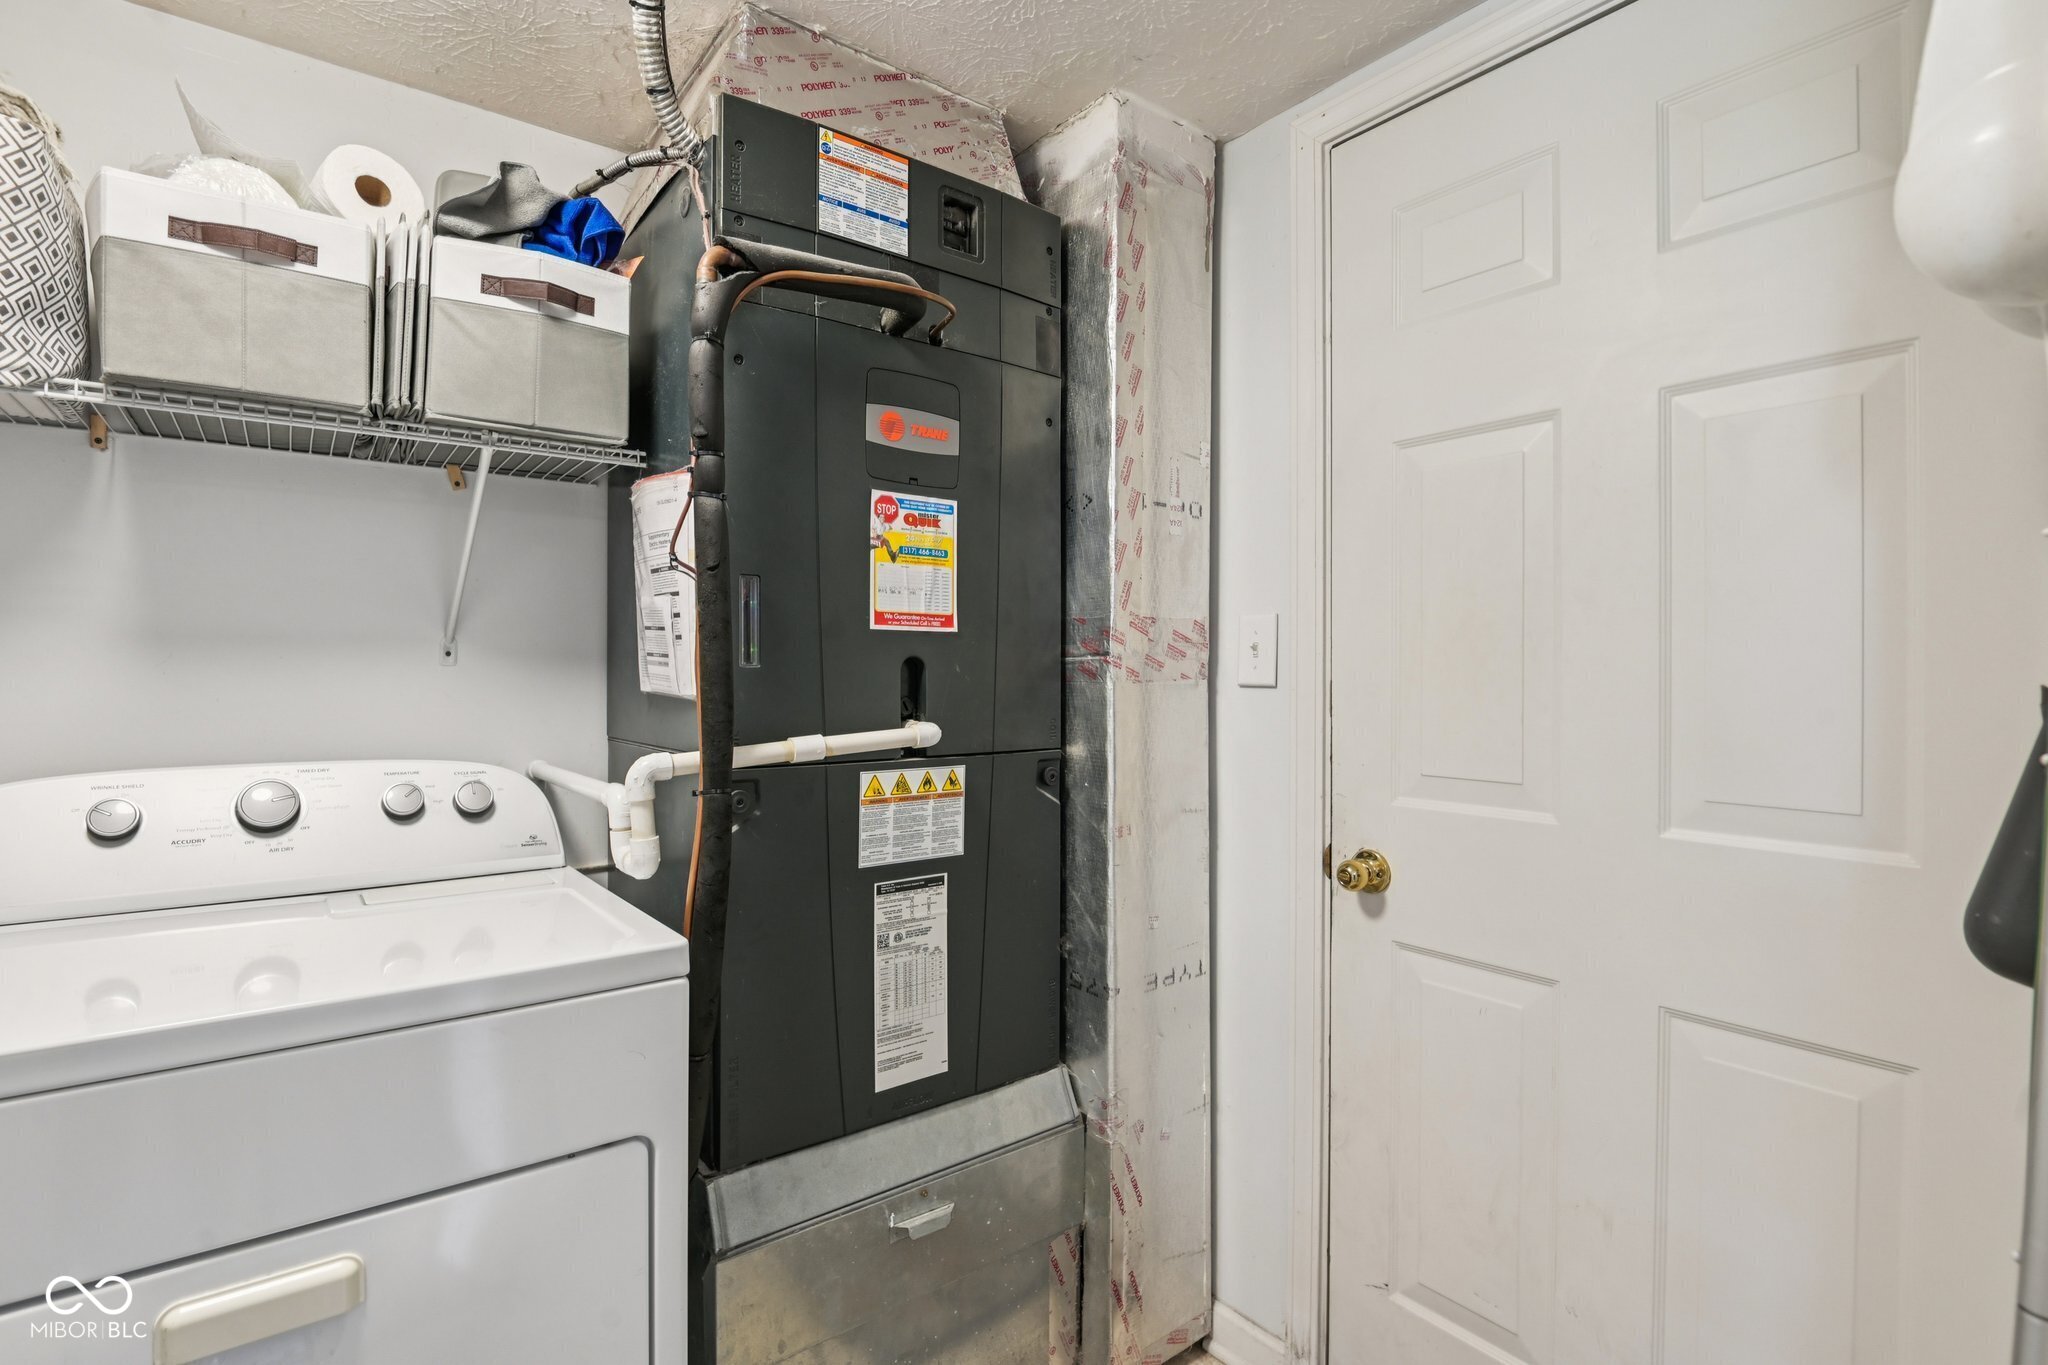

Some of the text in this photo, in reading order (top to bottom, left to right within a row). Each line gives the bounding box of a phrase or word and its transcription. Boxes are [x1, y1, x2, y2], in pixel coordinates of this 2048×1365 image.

[800, 81, 836, 92] POLYKEN
[874, 73, 906, 83] POLYKEN
[801, 107, 852, 120] POLYKEN 339
[730, 154, 742, 204] HEATER
[910, 423, 949, 441] TRANE
[877, 503, 897, 515] STOP
[903, 512, 941, 529] QUIK
[171, 838, 206, 846] ACCUDRY
[1143, 960, 1206, 993] TYPE
[1112, 1183, 1127, 1216] POLYKEN
[1131, 1175, 1143, 1207] POLYKEN
[1049, 1254, 1065, 1287] POLYKEN
